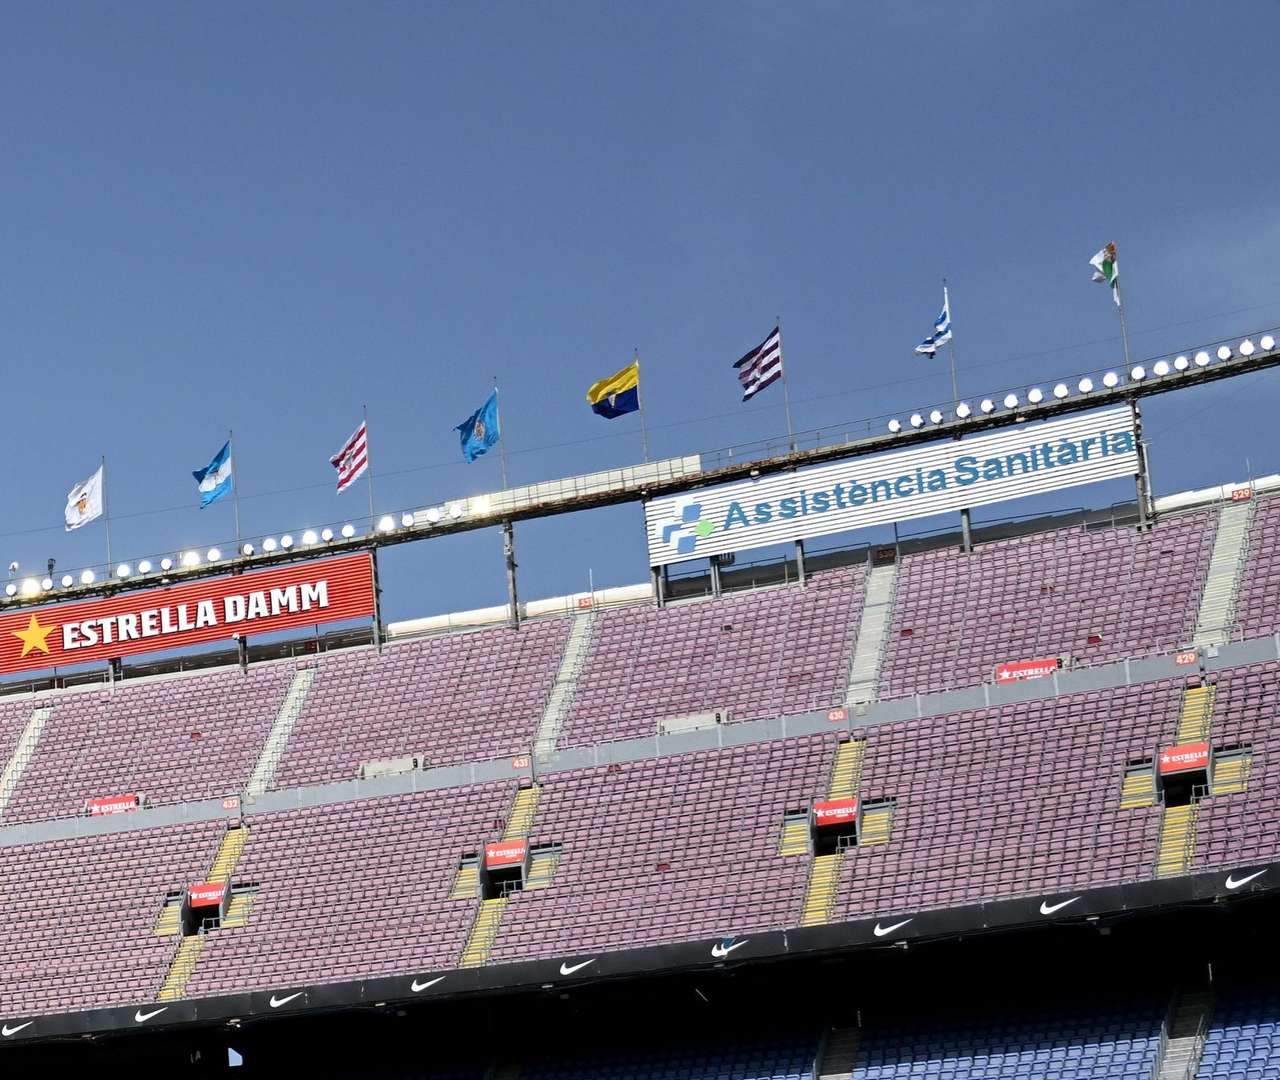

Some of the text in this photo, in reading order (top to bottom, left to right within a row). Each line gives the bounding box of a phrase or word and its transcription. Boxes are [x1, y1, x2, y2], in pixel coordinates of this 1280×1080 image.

[724, 428, 1134, 530] Assistència Sanitària
[1232, 489, 1251, 501] 529
[61, 580, 328, 650] ESTRELLA DAMM
[1176, 653, 1196, 665] 429
[1012, 664, 1055, 677] ESTRELLA
[828, 710, 844, 720] 430
[513, 757, 528, 768] 431
[1171, 751, 1208, 762] ESTRELLA
